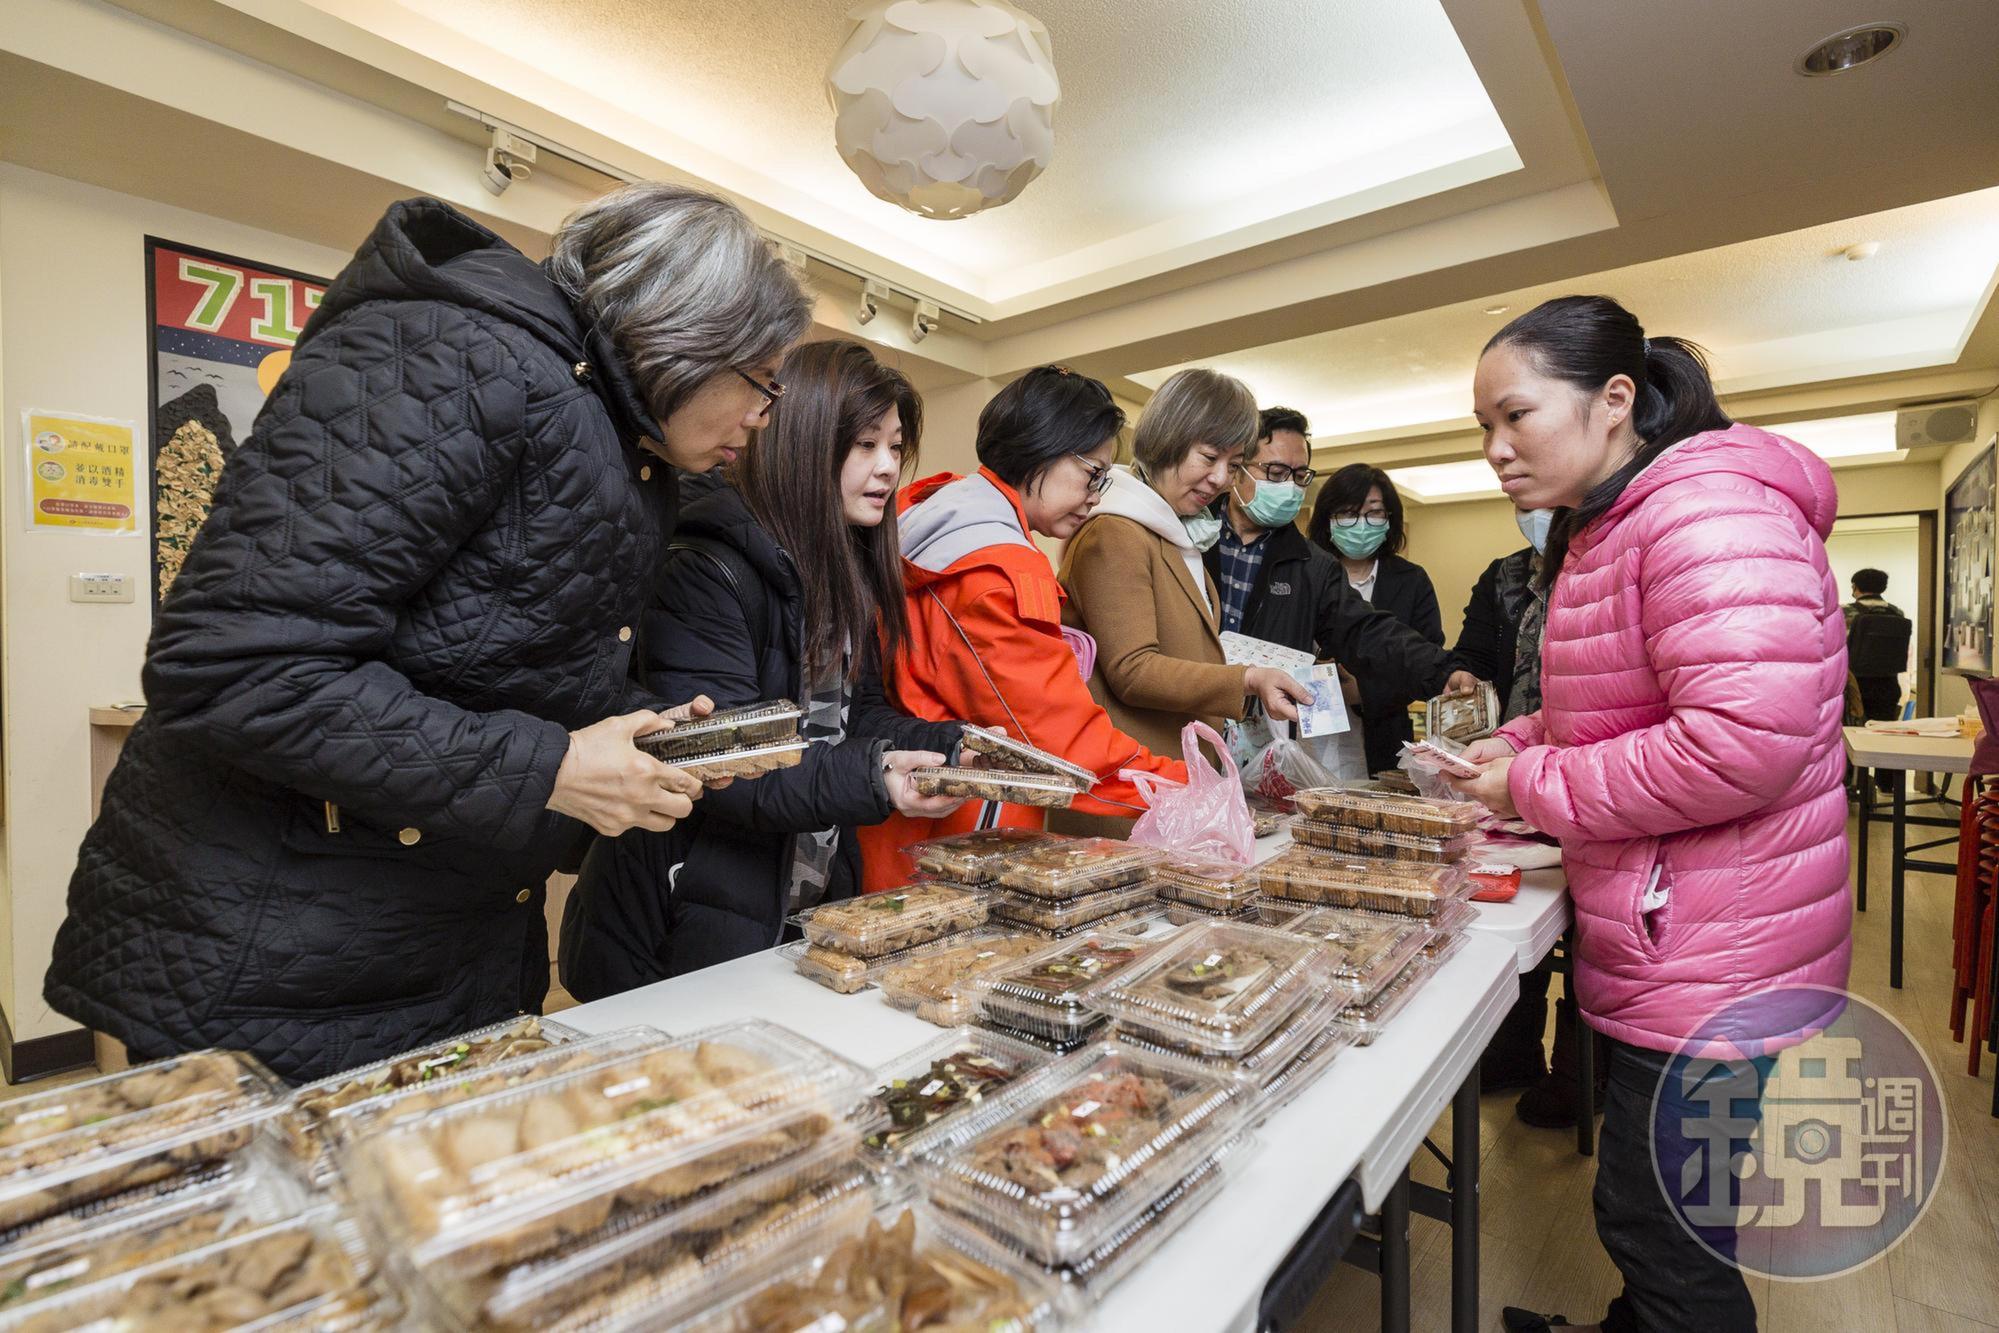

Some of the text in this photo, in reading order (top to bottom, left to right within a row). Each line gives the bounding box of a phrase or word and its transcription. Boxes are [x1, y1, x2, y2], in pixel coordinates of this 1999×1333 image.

[178, 257, 327, 347] 71
[75, 475, 125, 488] 消毒雙手
